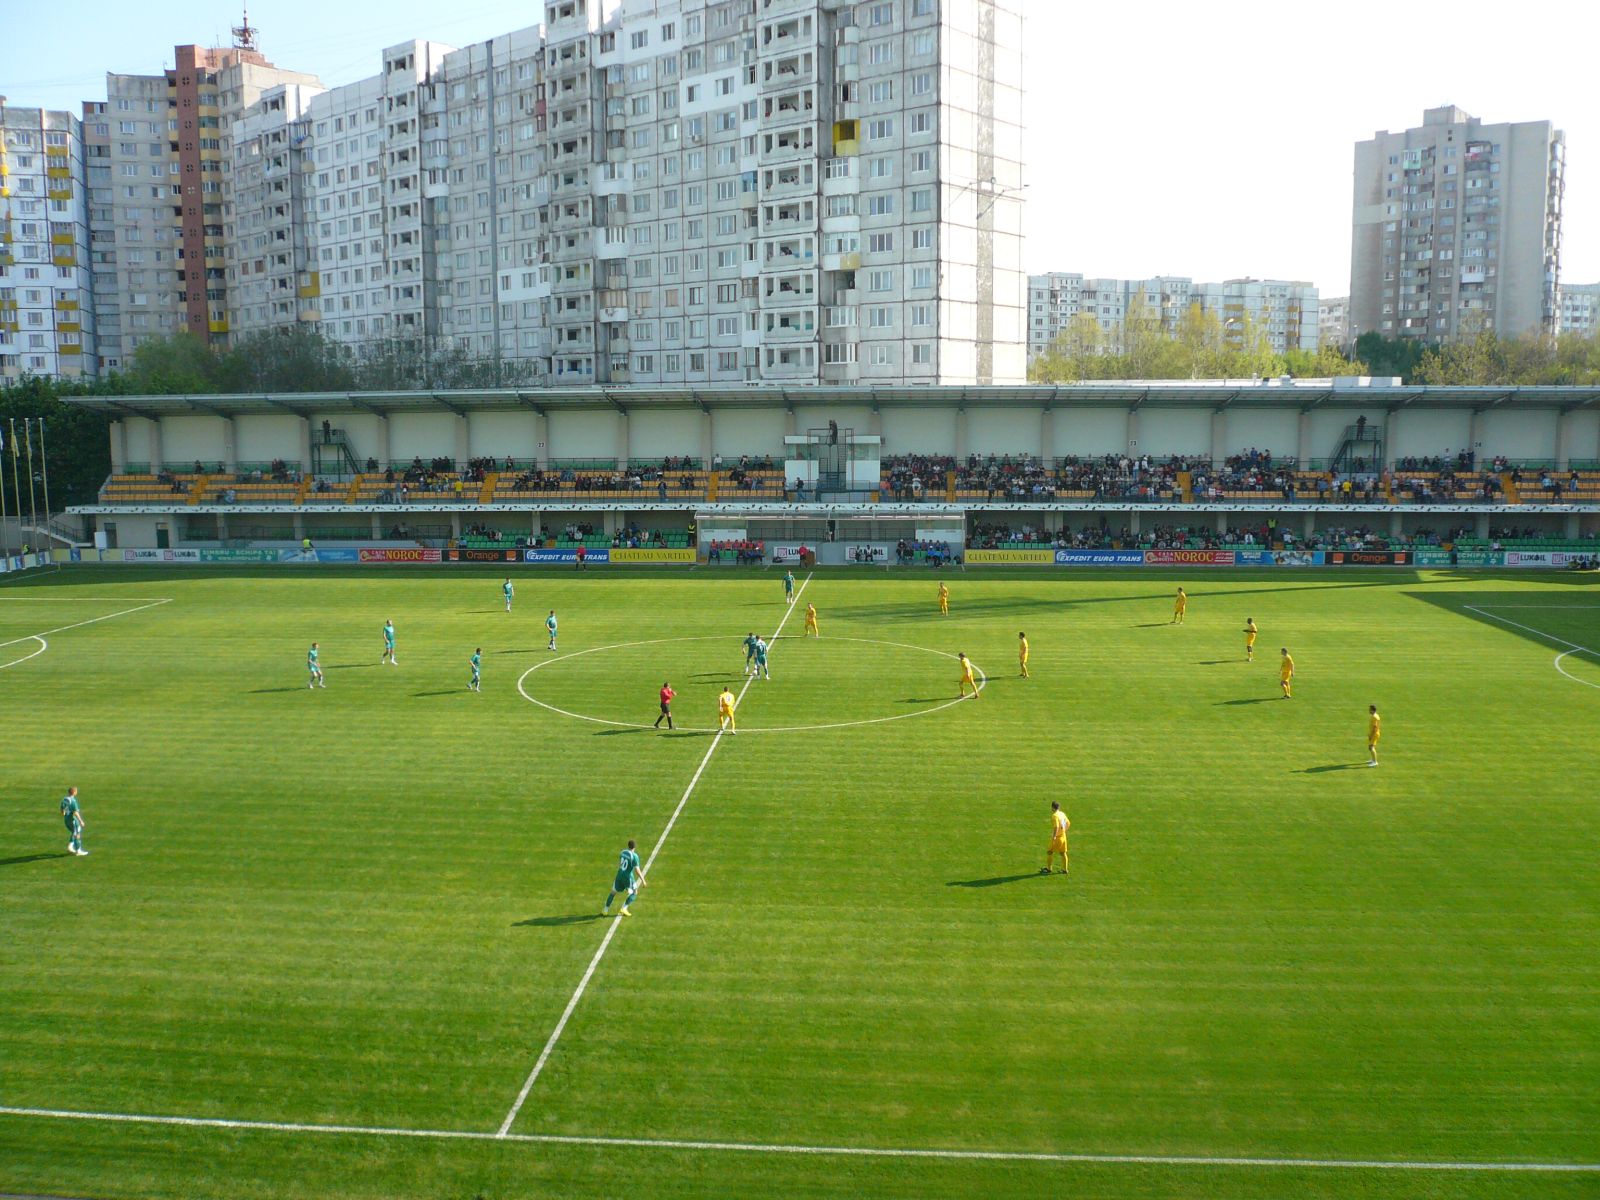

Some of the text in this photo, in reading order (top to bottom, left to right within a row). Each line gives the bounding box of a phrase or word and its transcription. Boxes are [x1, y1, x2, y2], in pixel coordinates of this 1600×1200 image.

[386, 550, 422, 561] NOROC
[466, 550, 500, 561] Orange
[530, 553, 608, 561] EXPEDIT EUR TRANS
[1060, 554, 1142, 562] EXPEDIT EURO TRANS
[1174, 551, 1214, 562] NOROC
[1351, 553, 1387, 564] Orange
